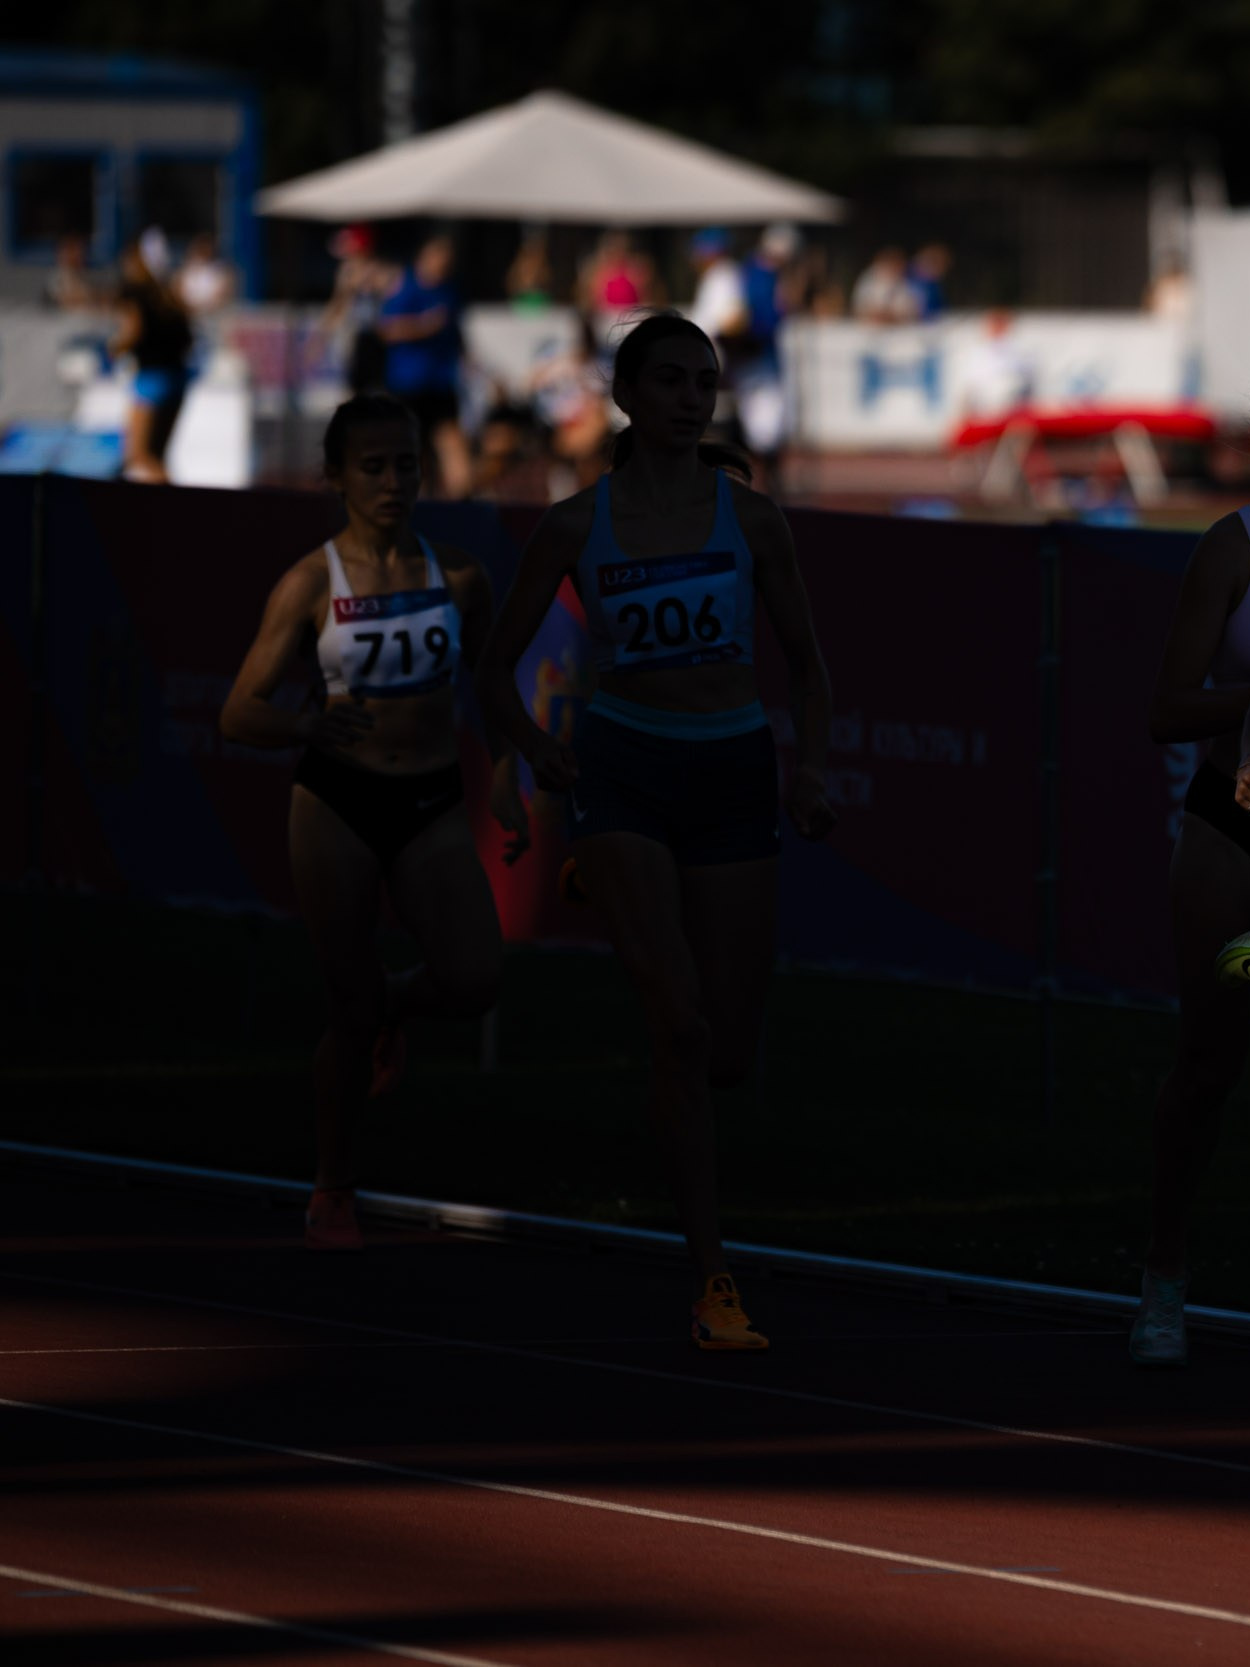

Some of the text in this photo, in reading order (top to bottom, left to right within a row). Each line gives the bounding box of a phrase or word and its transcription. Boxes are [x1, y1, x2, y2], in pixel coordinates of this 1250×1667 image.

[604, 566, 648, 587] U23
[338, 599, 380, 616] U23
[618, 594, 722, 653] 206
[354, 626, 450, 676] 719
